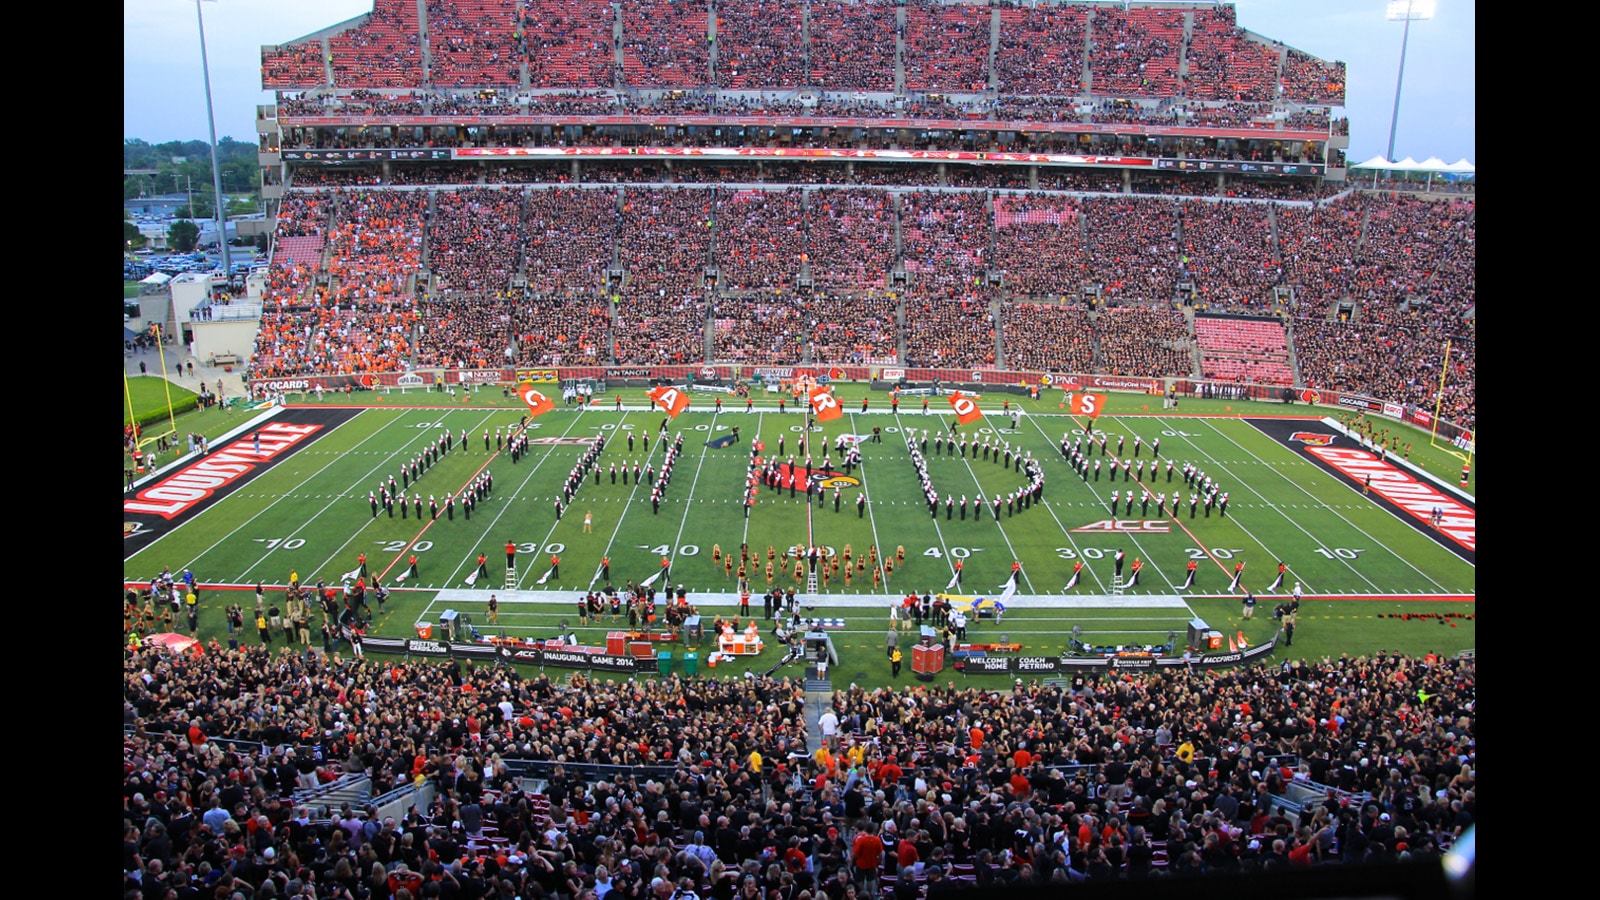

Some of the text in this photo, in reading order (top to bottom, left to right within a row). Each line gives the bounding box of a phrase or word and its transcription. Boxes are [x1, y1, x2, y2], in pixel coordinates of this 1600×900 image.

[1055, 376, 1078, 386] PNC
[526, 390, 546, 406] C
[660, 389, 678, 411] A
[814, 393, 836, 412] R
[1080, 395, 1096, 415] S
[124, 422, 318, 515] LOUISVILLE
[1069, 519, 1172, 533] ACC
[265, 538, 305, 550] 10
[382, 540, 434, 552] 20
[514, 542, 566, 554] 30
[651, 544, 700, 556] 40
[923, 547, 971, 559] 40
[1055, 547, 1104, 560] 30
[1184, 549, 1234, 560] 20
[1314, 548, 1359, 560] 10
[514, 651, 536, 659] ACC
[543, 652, 634, 667] INAUGURAL GAME 2014
[1203, 653, 1242, 664] #ACCFIRSTS
